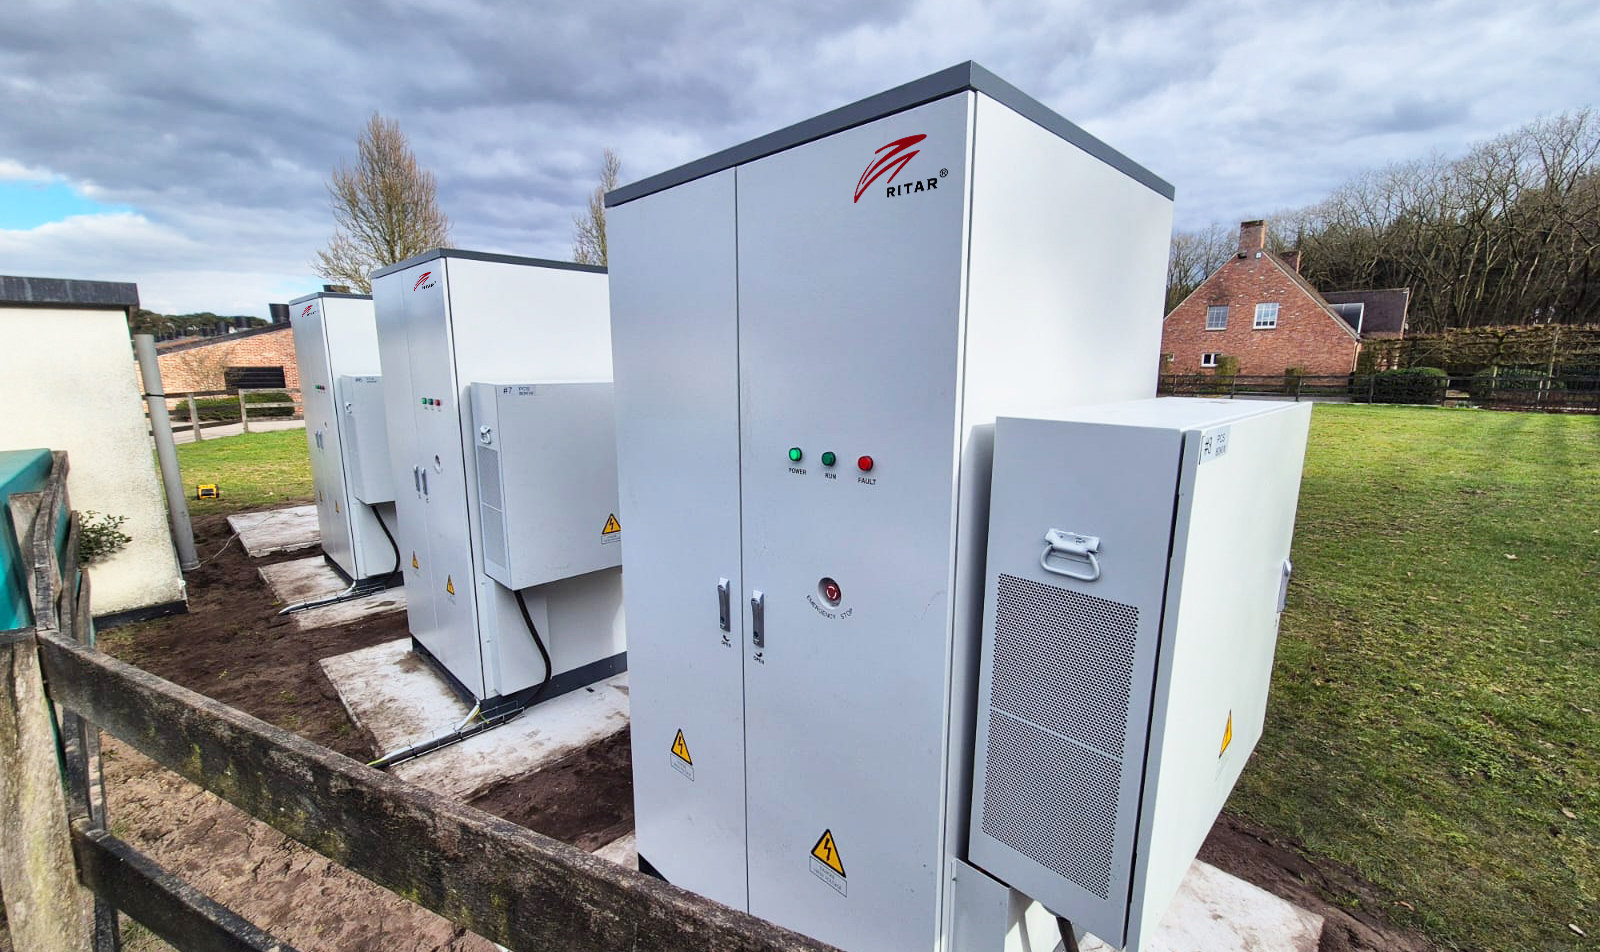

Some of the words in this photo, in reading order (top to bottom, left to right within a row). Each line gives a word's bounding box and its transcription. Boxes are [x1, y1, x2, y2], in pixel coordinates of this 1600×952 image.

[788, 467, 807, 475] POWER
[824, 472, 837, 480] RUN
[857, 477, 876, 485] FAULT
[806, 594, 836, 620] EMERGENCY
[840, 607, 853, 620] STOP
